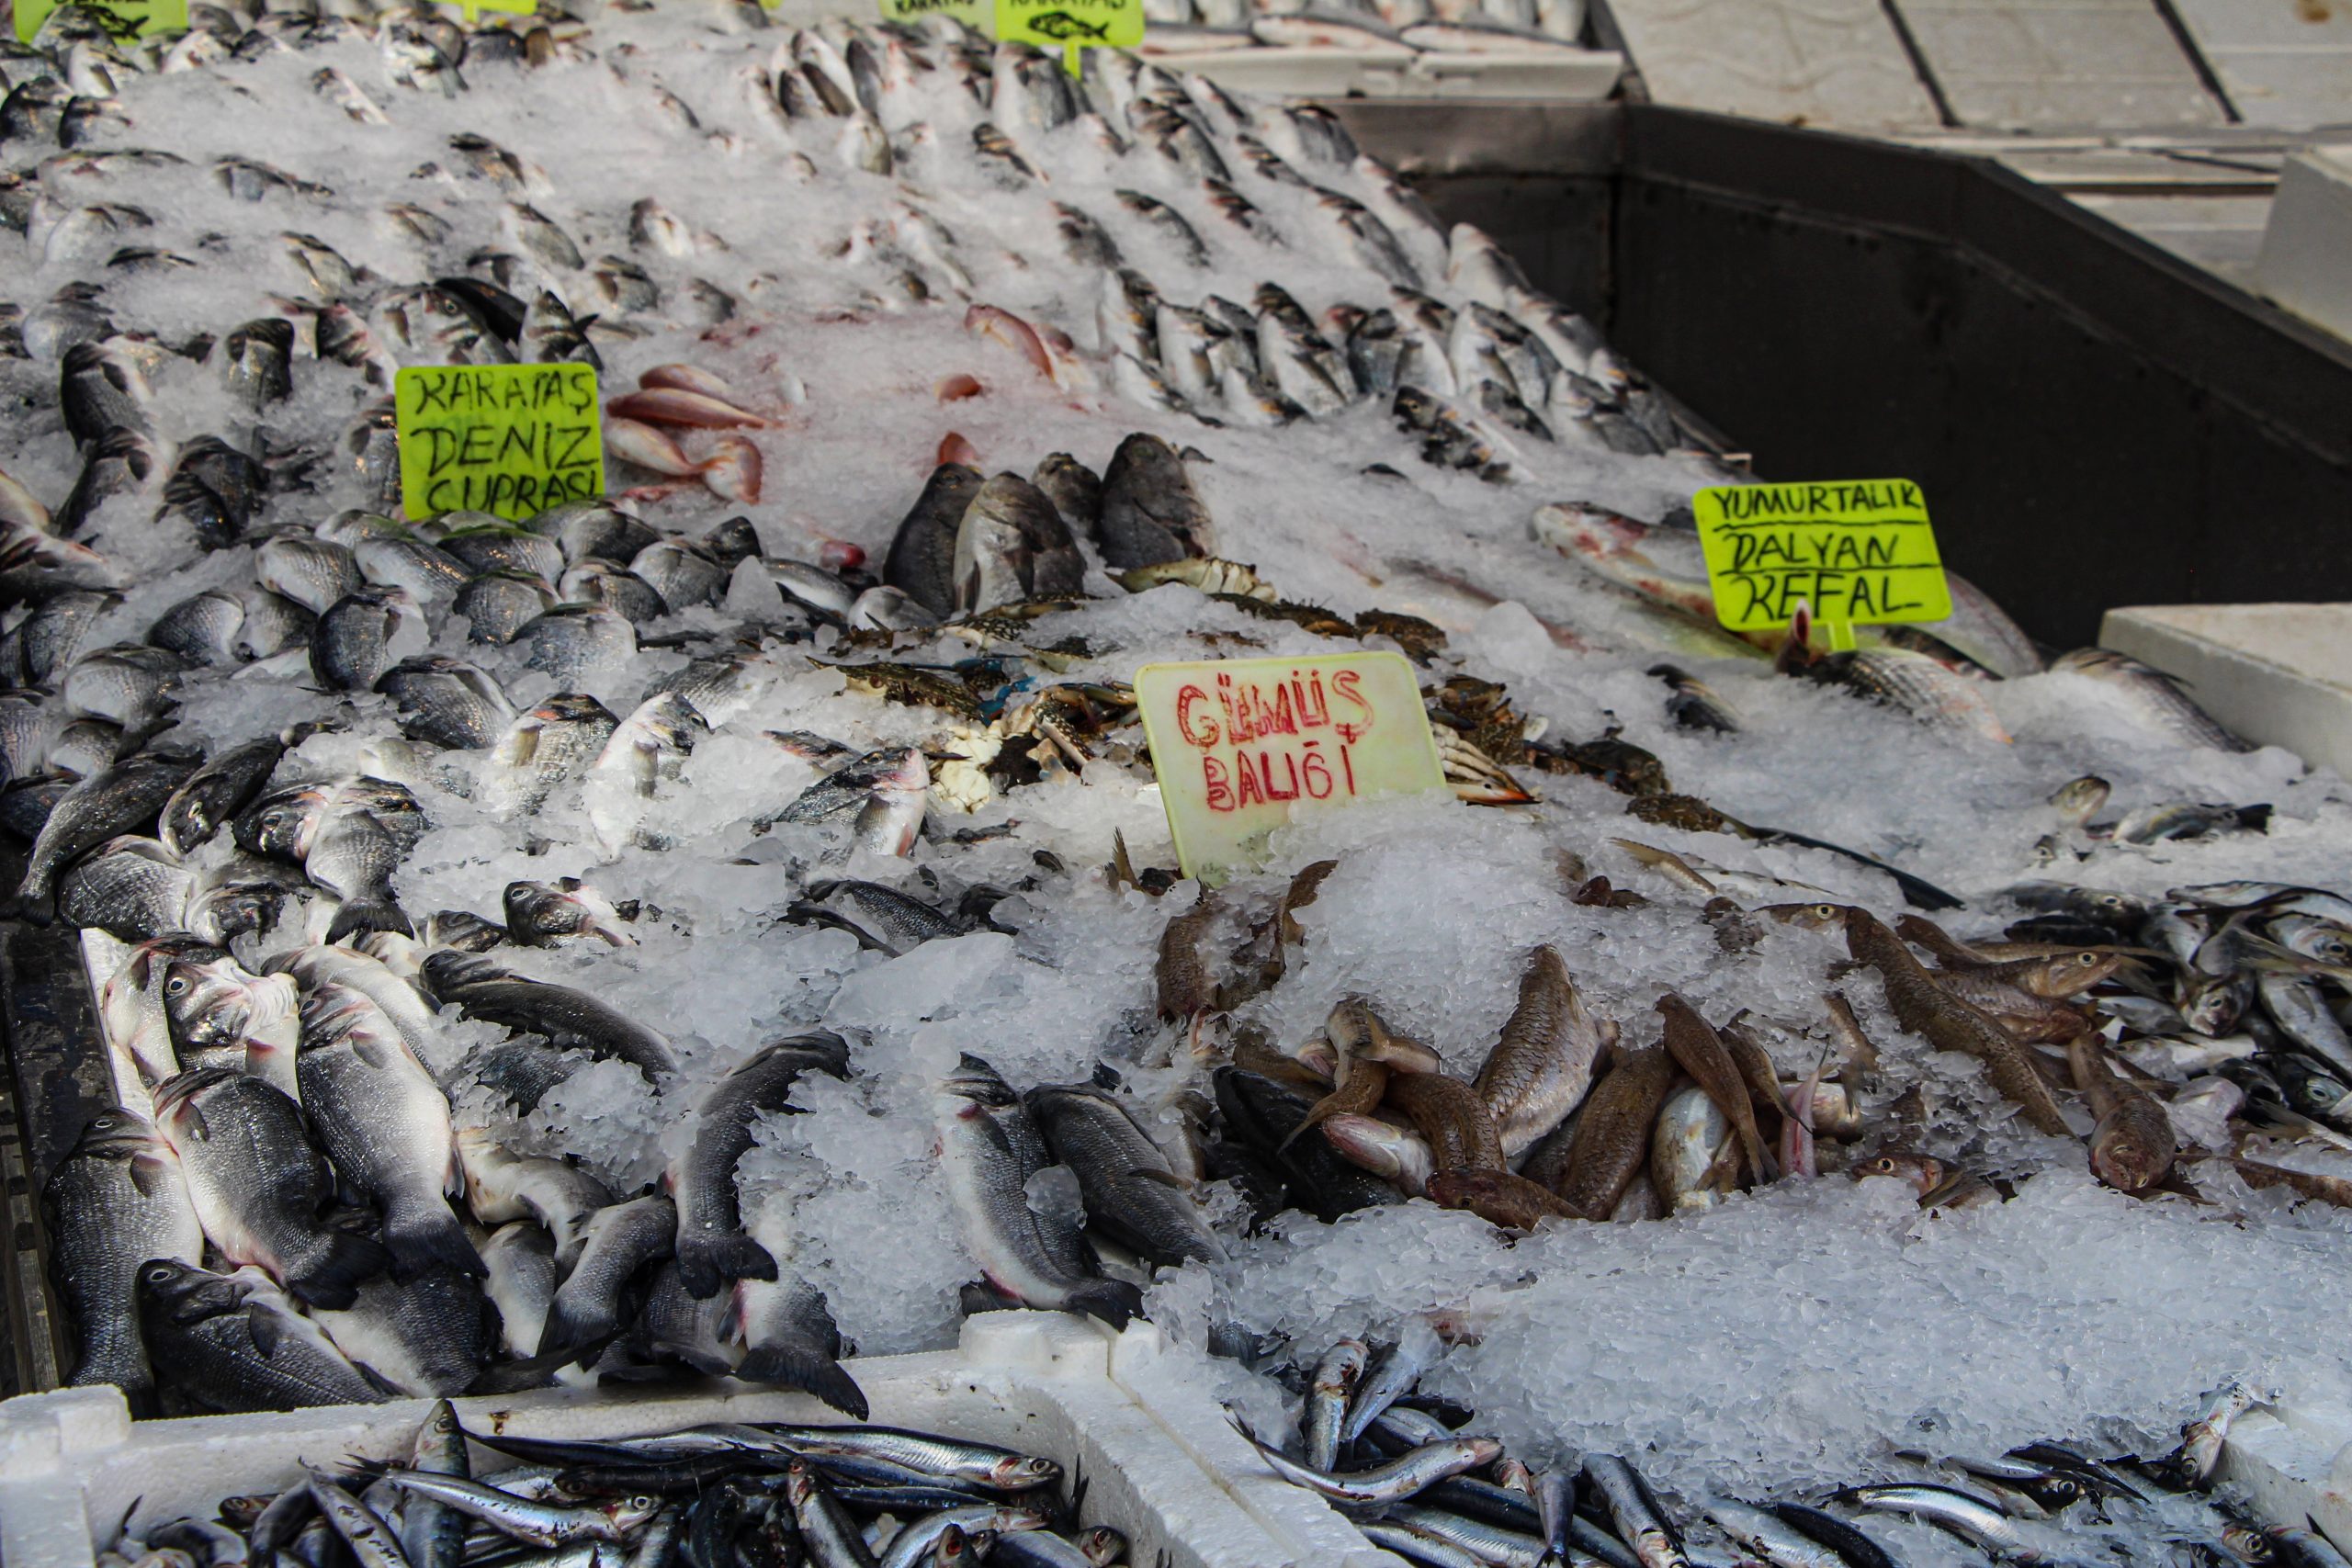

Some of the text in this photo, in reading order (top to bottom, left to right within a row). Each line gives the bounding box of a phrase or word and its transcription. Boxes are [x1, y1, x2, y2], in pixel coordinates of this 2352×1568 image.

[410, 422, 599, 477] DENİZ
[1712, 483, 1923, 519] YUMURTALIK
[1723, 533, 1899, 570] DALYAN
[1730, 573, 1923, 623] KEFAL
